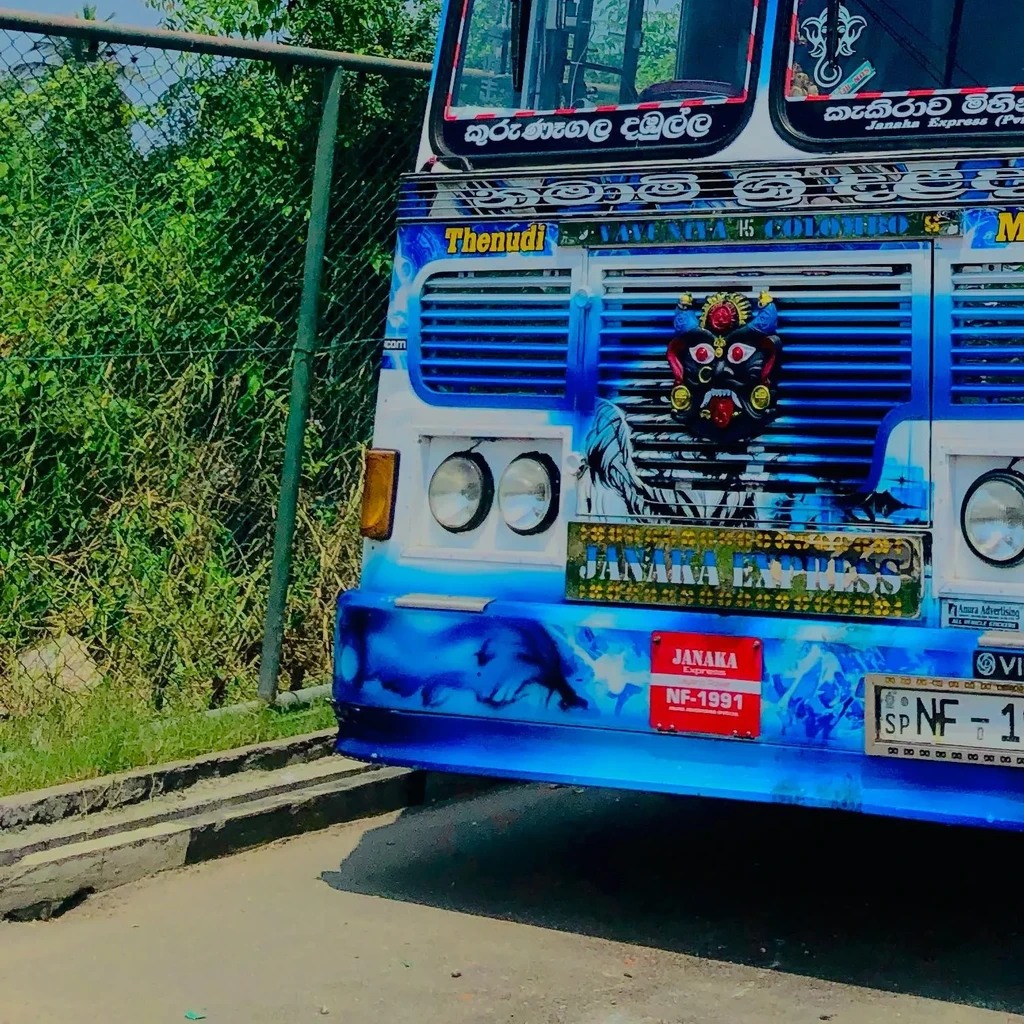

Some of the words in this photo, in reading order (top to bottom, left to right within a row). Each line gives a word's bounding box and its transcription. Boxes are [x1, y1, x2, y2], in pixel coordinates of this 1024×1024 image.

[823, 97, 953, 122] කැකිරාව
[619, 107, 713, 142] දඹුල්ල
[927, 116, 988, 130] Express
[444, 224, 546, 255] Thenudi
[981, 605, 1020, 620] Advertising
[672, 648, 738, 669] JANAKA
[682, 665, 727, 676] Express
[666, 687, 743, 710] NF-1991
[884, 712, 911, 735] SP
